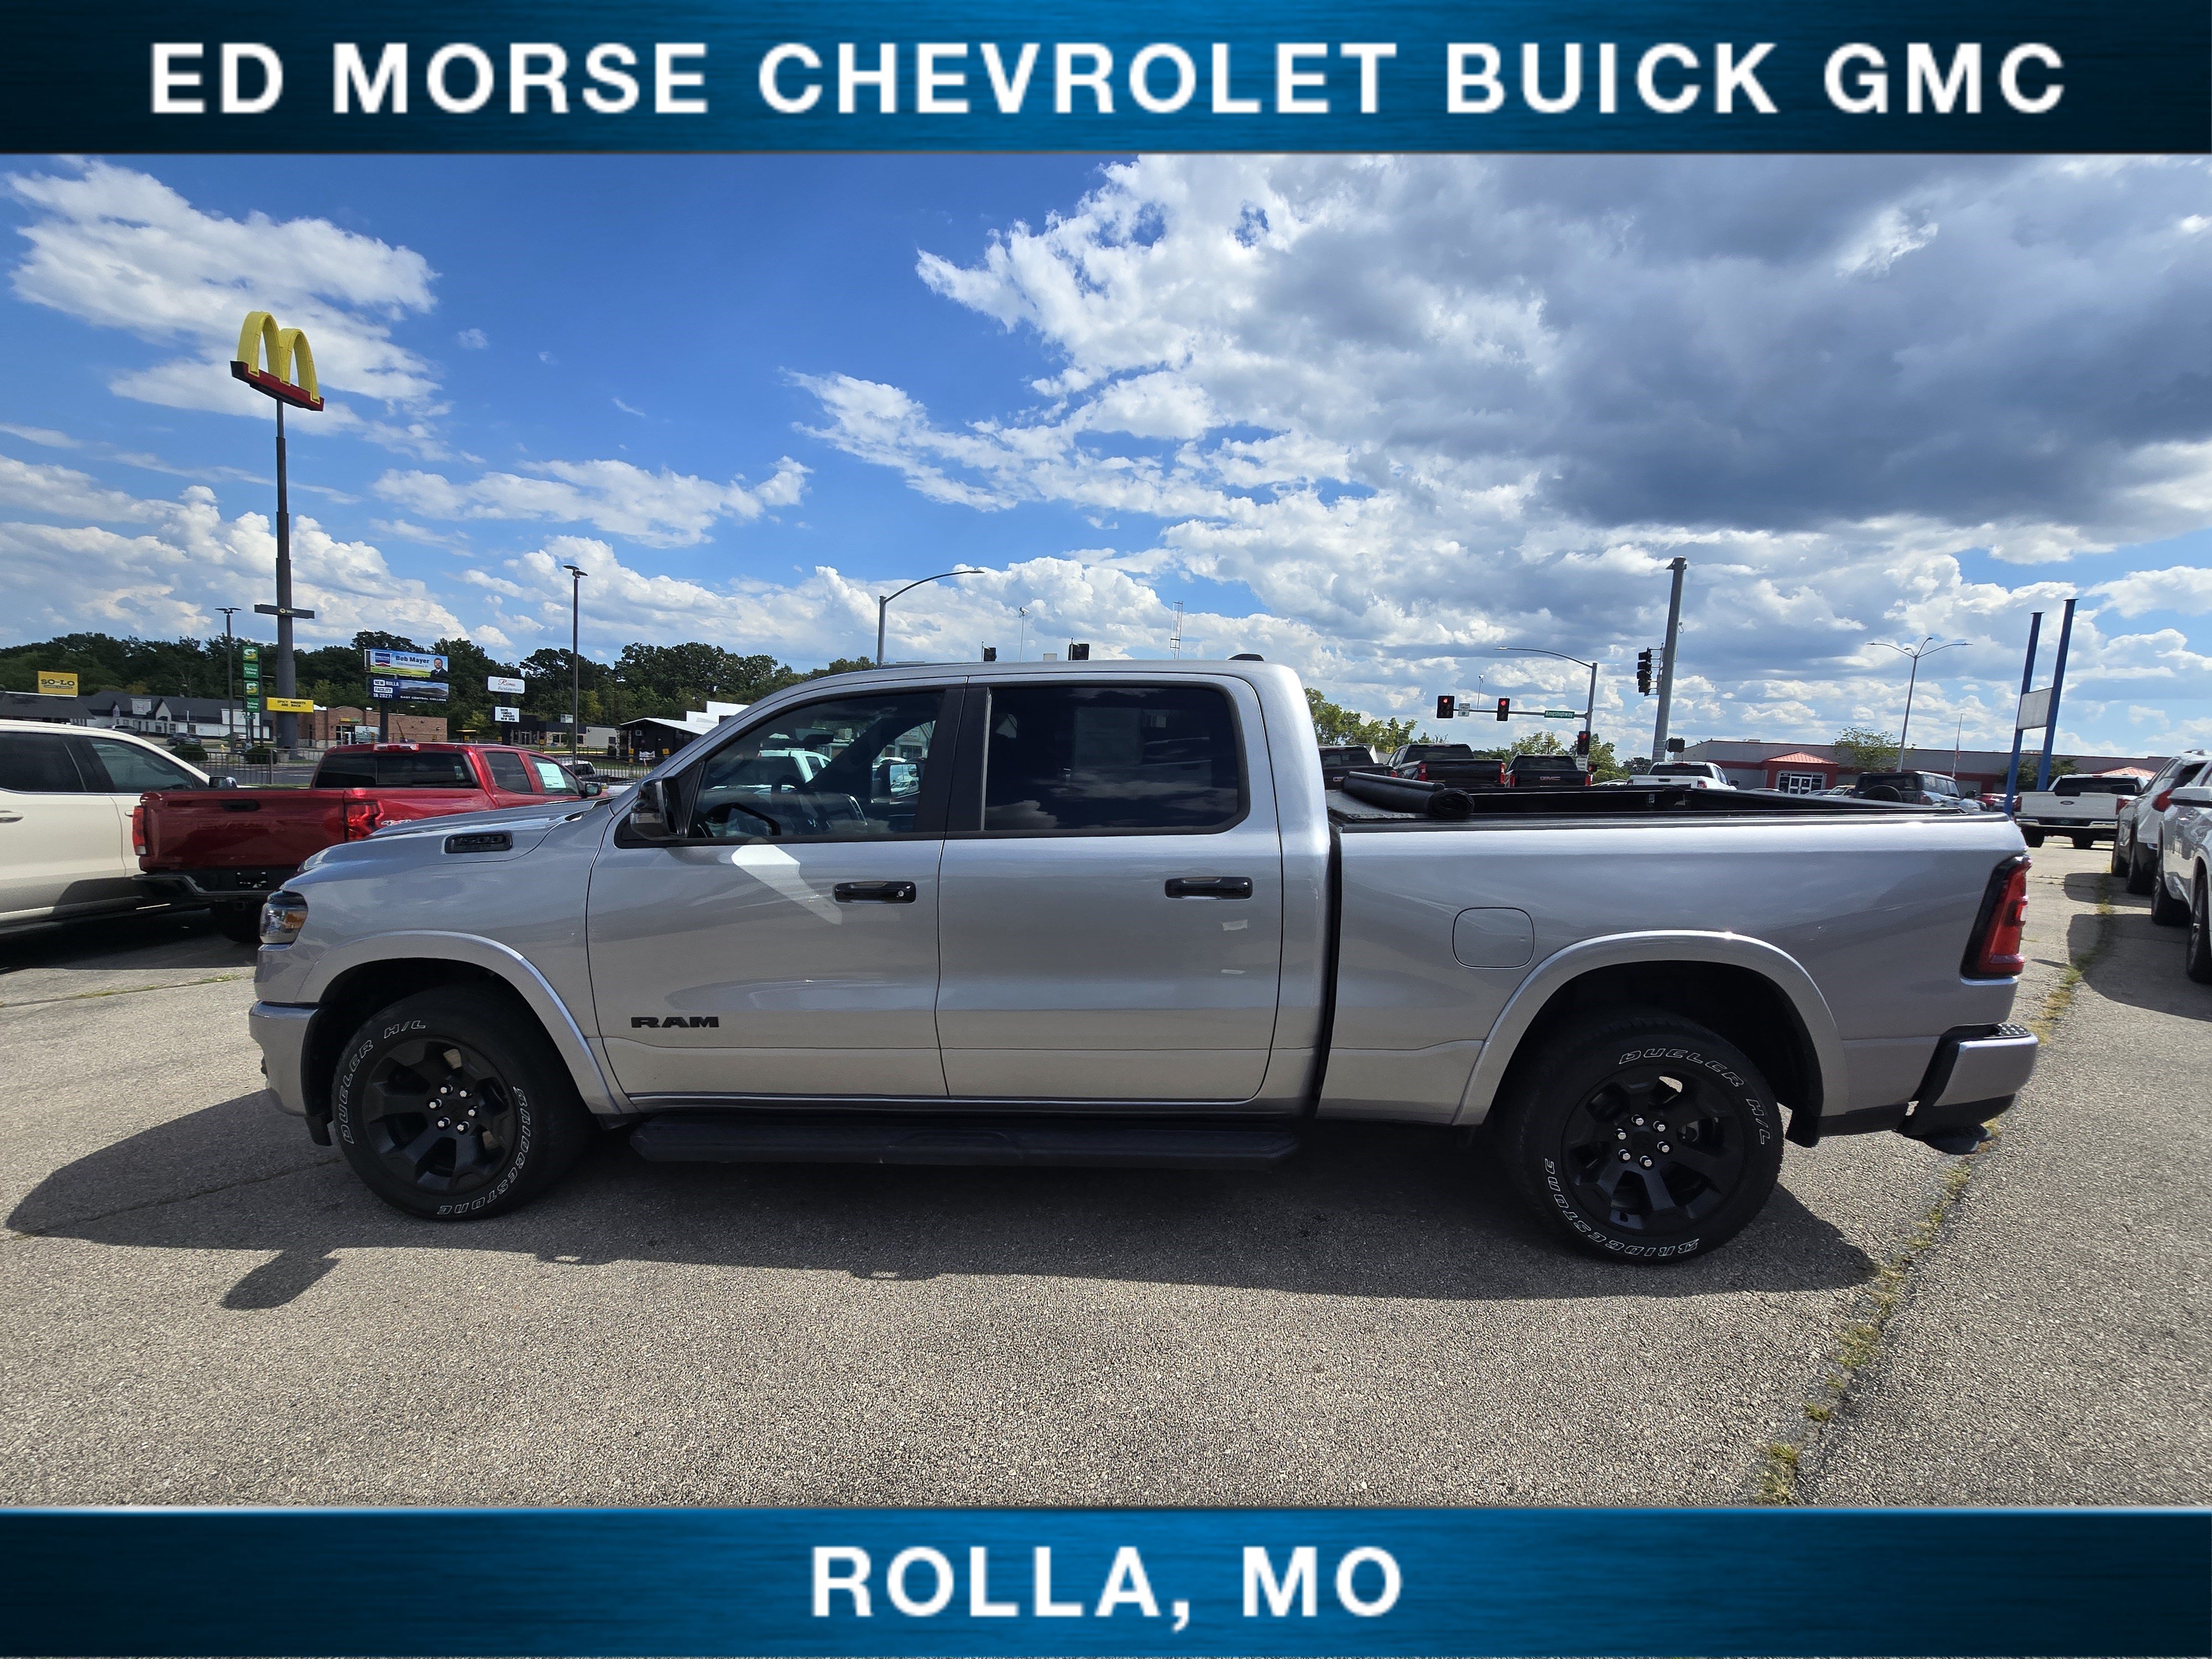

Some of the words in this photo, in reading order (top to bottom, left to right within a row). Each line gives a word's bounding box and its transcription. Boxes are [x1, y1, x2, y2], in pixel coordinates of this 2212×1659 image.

[630, 1016, 719, 1028] RAM
[1618, 1047, 1745, 1087] DUELER
[338, 1039, 374, 1144] DUELER
[436, 1086, 531, 1215] BRIDGESTONE
[1544, 1157, 1700, 1258] BRIDGESTONE
